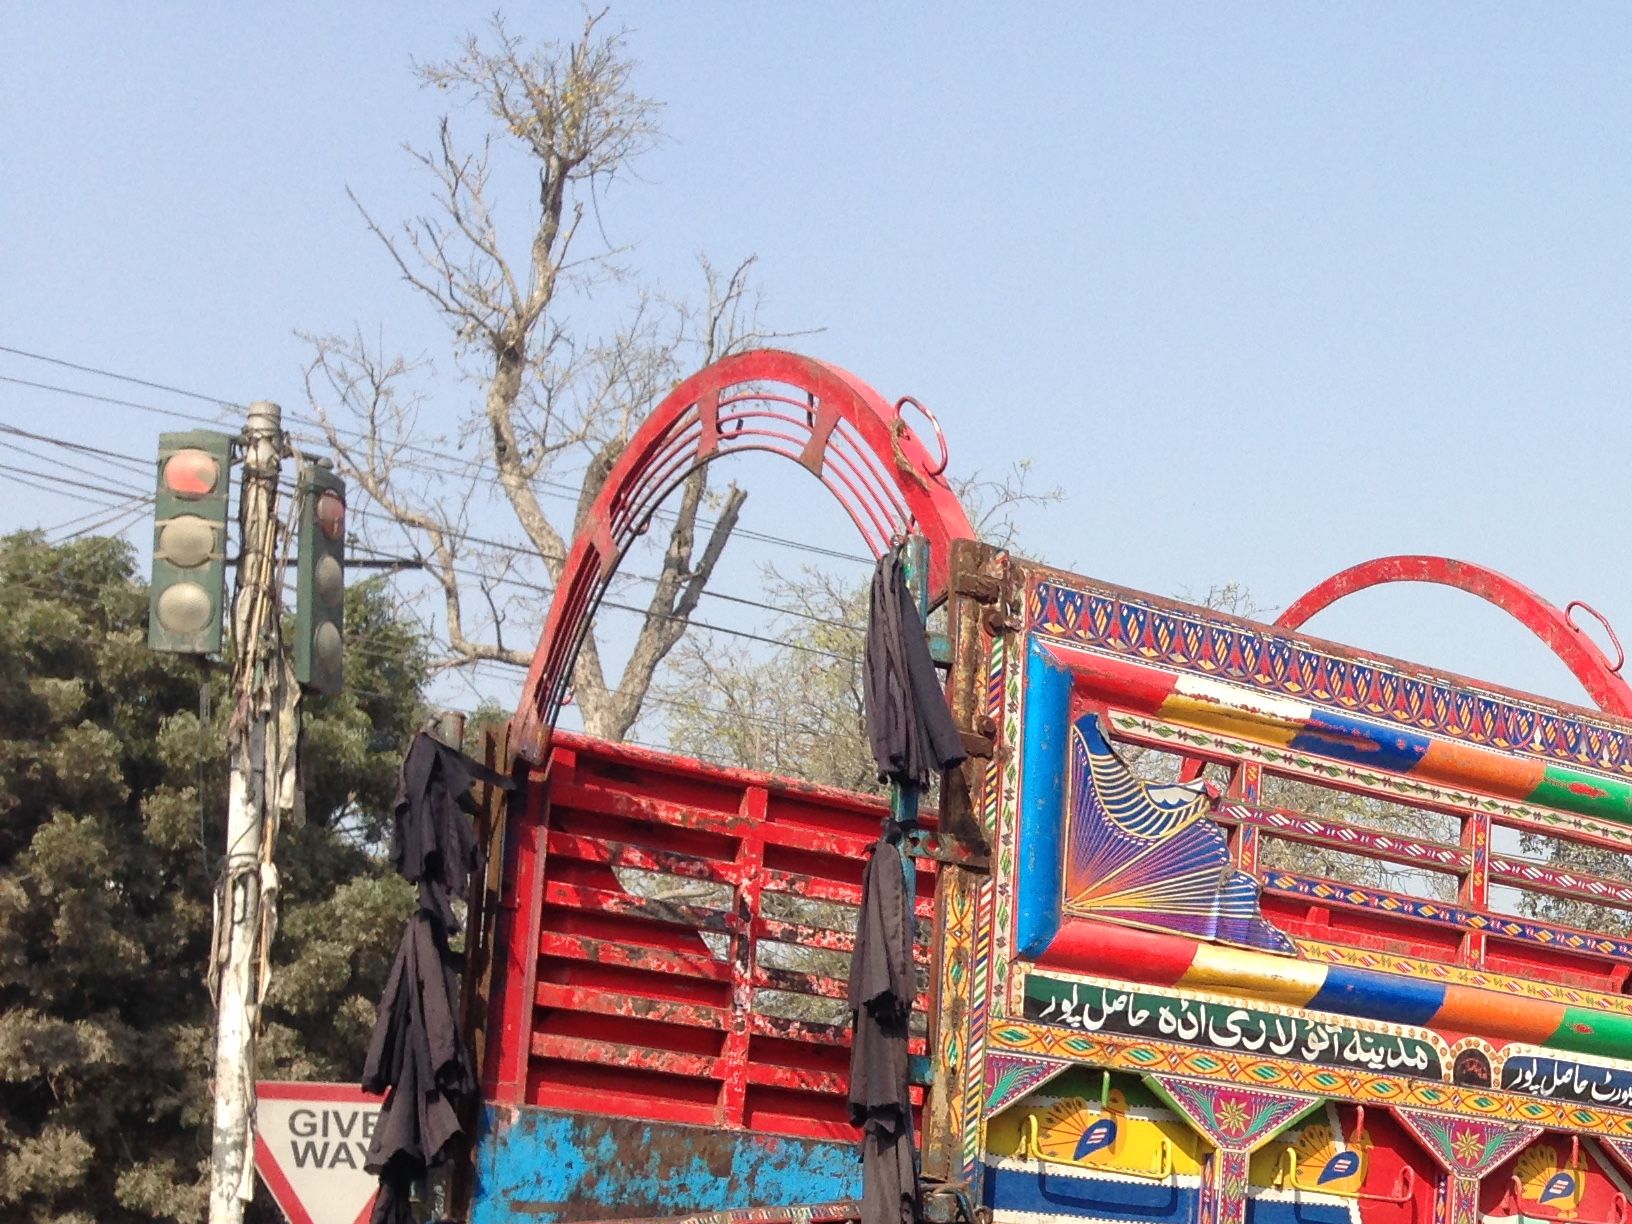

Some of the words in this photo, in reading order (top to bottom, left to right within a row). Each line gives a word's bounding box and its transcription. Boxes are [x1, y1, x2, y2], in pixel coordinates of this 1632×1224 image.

[1038, 983, 1082, 1028] پور
[1083, 988, 1150, 1031] حاصل
[1158, 998, 1206, 1040] اڈہ
[1209, 1010, 1297, 1056] لاری
[1506, 1058, 1540, 1096] پور
[1540, 1062, 1589, 1097] حاصل
[288, 1109, 379, 1138] GIVE
